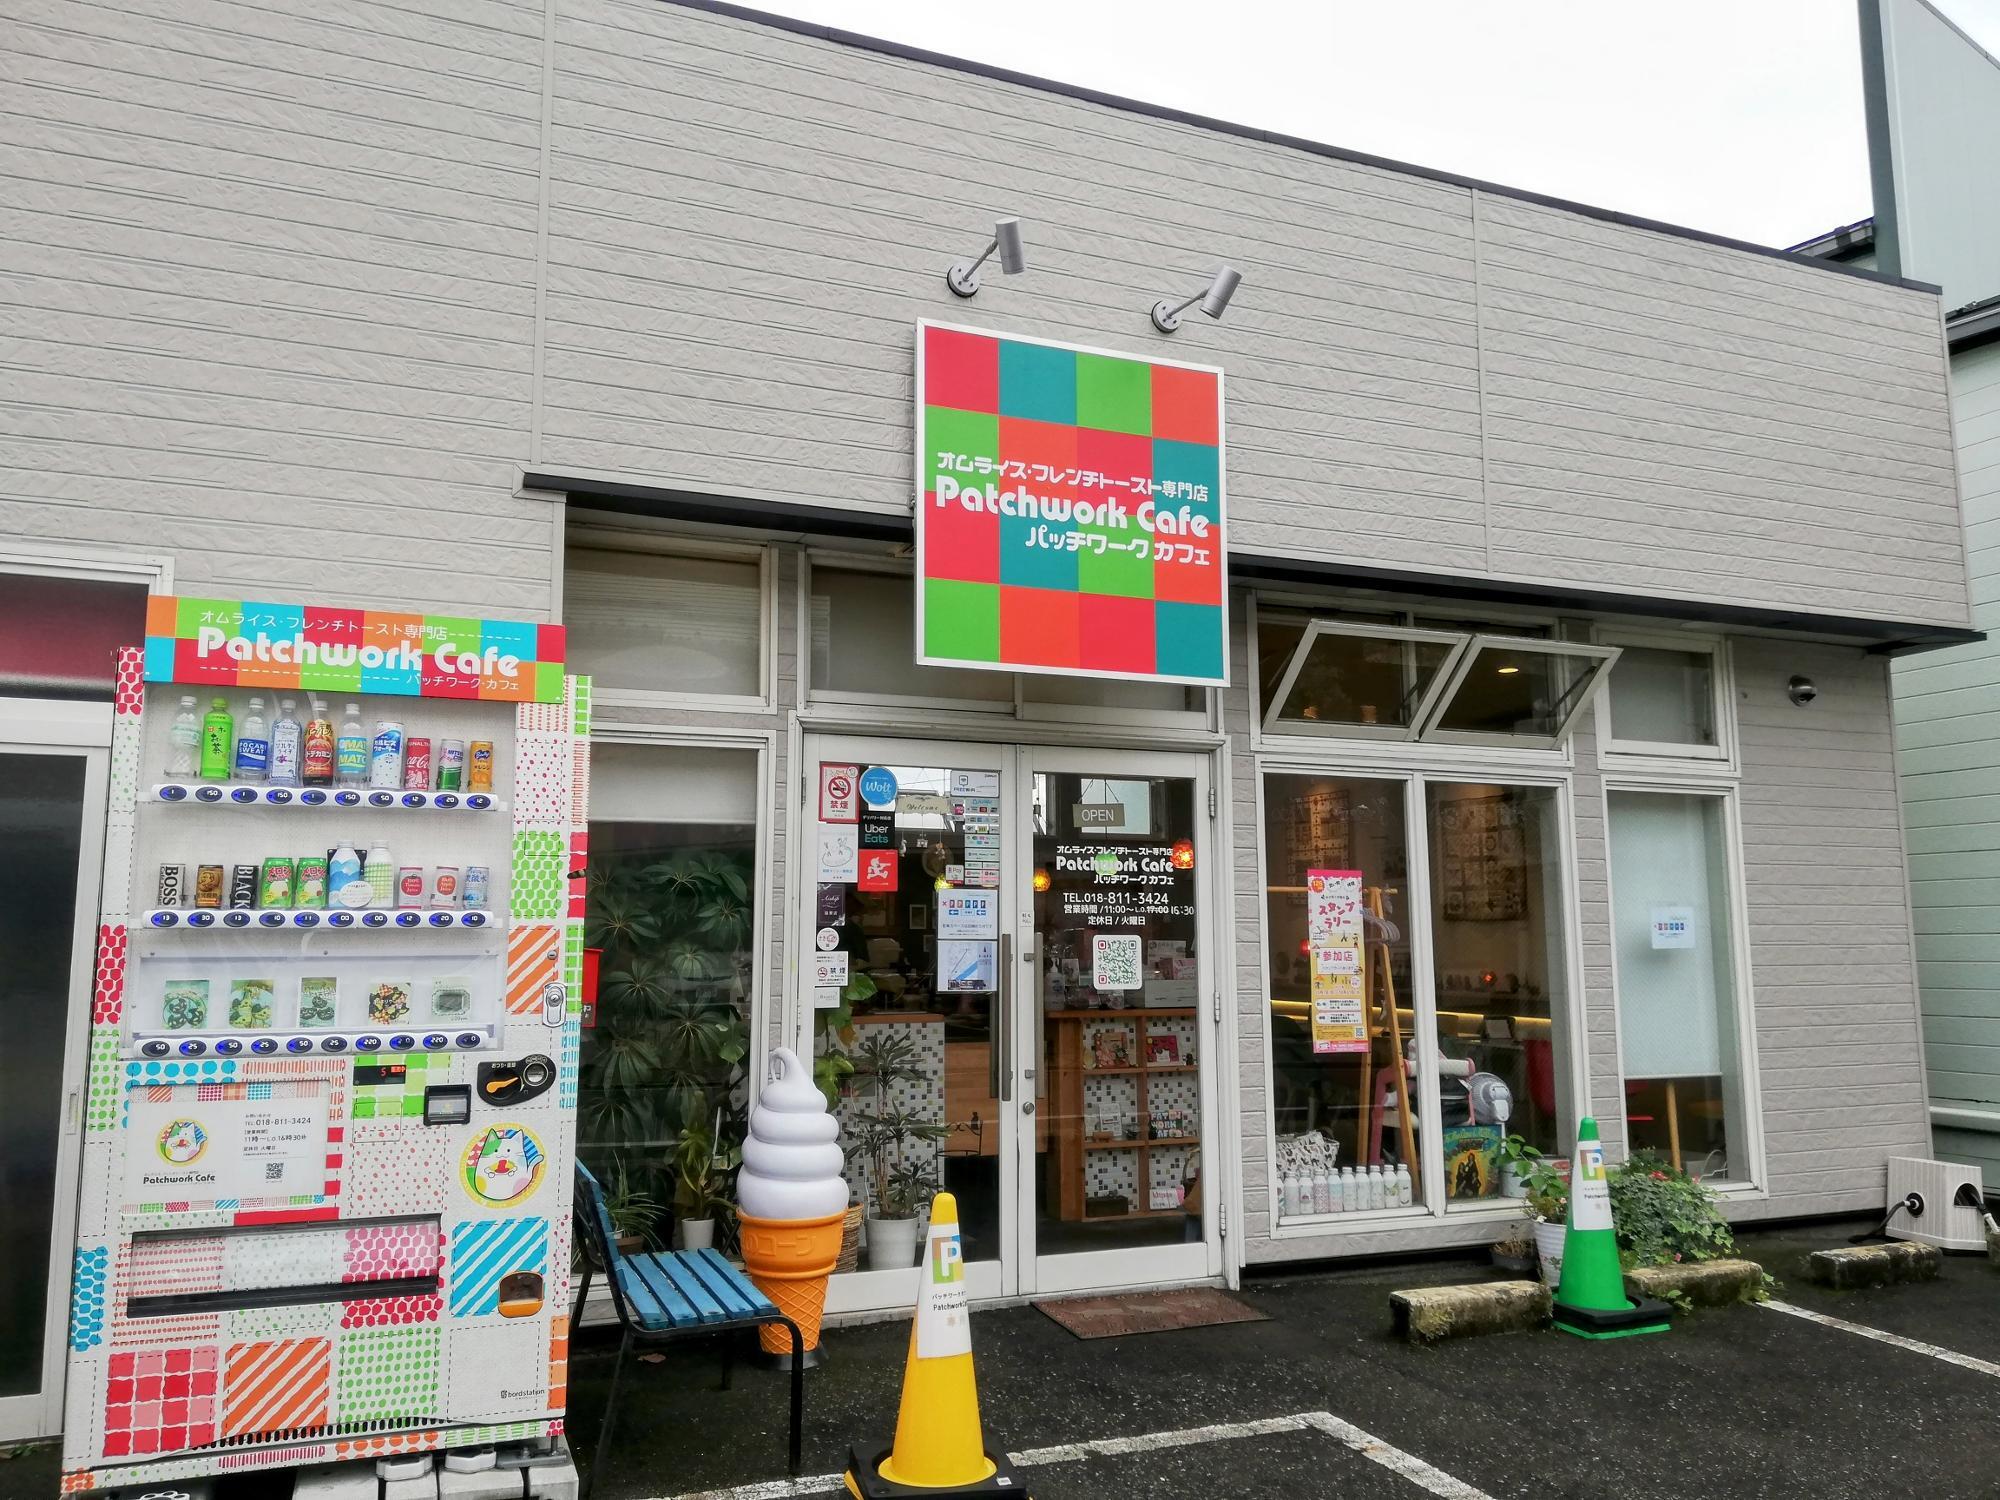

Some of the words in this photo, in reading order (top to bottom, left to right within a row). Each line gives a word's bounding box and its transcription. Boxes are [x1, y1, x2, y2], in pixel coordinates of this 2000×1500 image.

[937, 451, 1208, 502] オムライス・フレンチトースト専門店
[935, 475, 1128, 530] Patchwork
[1136, 500, 1209, 538] Cafe
[1025, 525, 1149, 559] パッチワーク
[1153, 542, 1210, 566] カフェ
[200, 610, 447, 640] オムライス・フレンチトースト専門店
[197, 627, 422, 671] Patchwork
[434, 648, 519, 678] Cafe
[866, 781, 892, 793] Wolt
[830, 800, 849, 809] 禁煙
[906, 803, 938, 811] Welcome
[1081, 809, 1114, 822] OPEN
[864, 824, 888, 833] Uber
[864, 834, 888, 843] Eats
[1056, 845, 1173, 856] オムライス・フレンチトースト専門店
[1141, 857, 1174, 872] Cafe
[163, 866, 179, 905] BOSS
[234, 866, 253, 909] BLACK
[1171, 906, 1194, 916] 16:30
[1319, 901, 1355, 915] スタンプ
[1088, 916, 1112, 925] 定休日
[1121, 916, 1146, 926] 火曜日
[1324, 917, 1351, 928] ラリー
[1322, 951, 1352, 961] 参加店
[256, 1117, 311, 1126] 018-811-3424
[143, 1175, 193, 1184] Patchwork
[196, 1174, 215, 1182] Cafe
